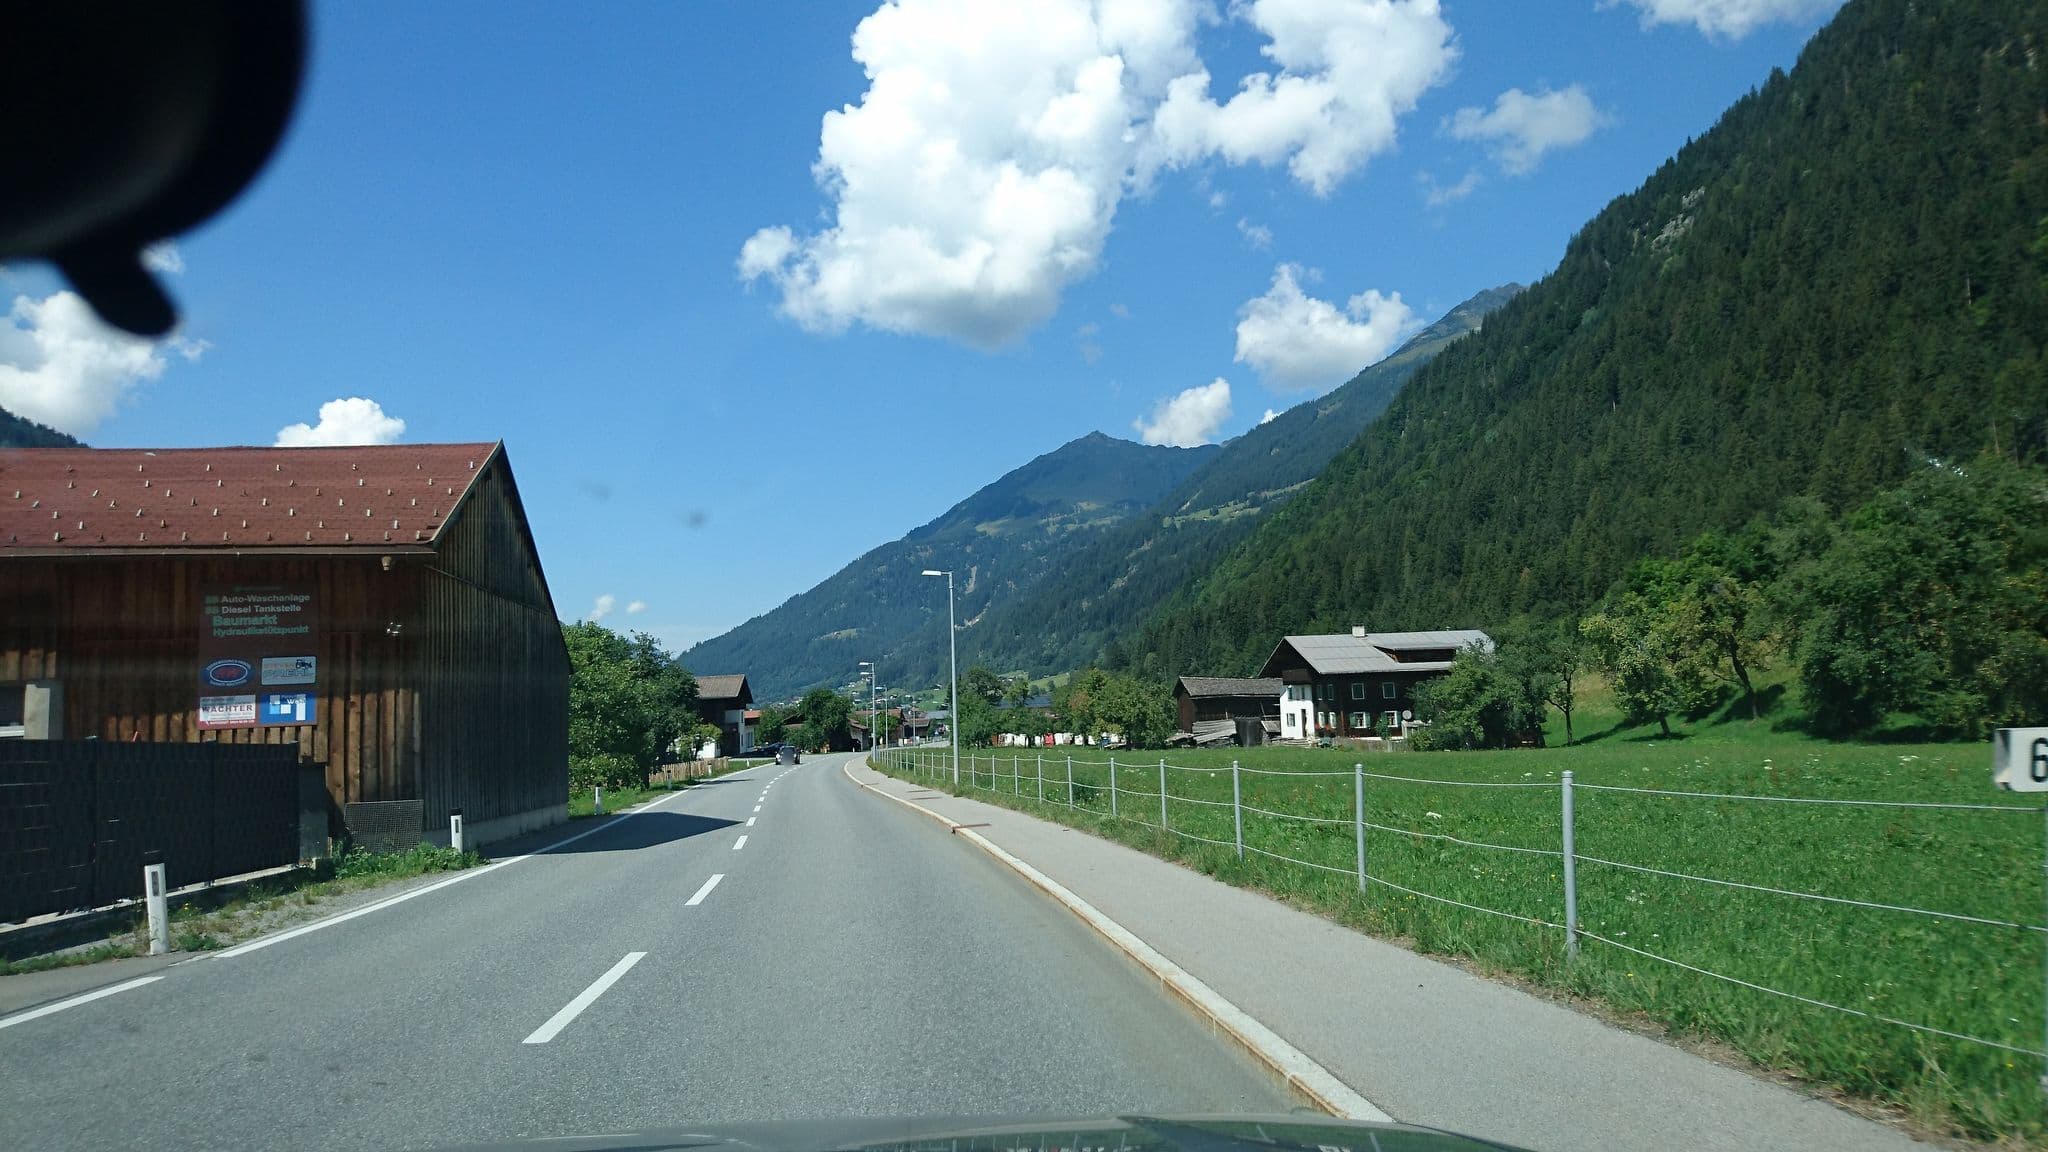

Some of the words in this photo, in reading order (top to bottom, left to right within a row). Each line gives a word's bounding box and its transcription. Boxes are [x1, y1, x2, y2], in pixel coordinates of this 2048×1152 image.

[221, 594, 310, 603] Auto-Waschanlage
[221, 605, 251, 614] Diesel
[253, 604, 302, 613] Tankstelle
[213, 615, 278, 626] Baumarkt
